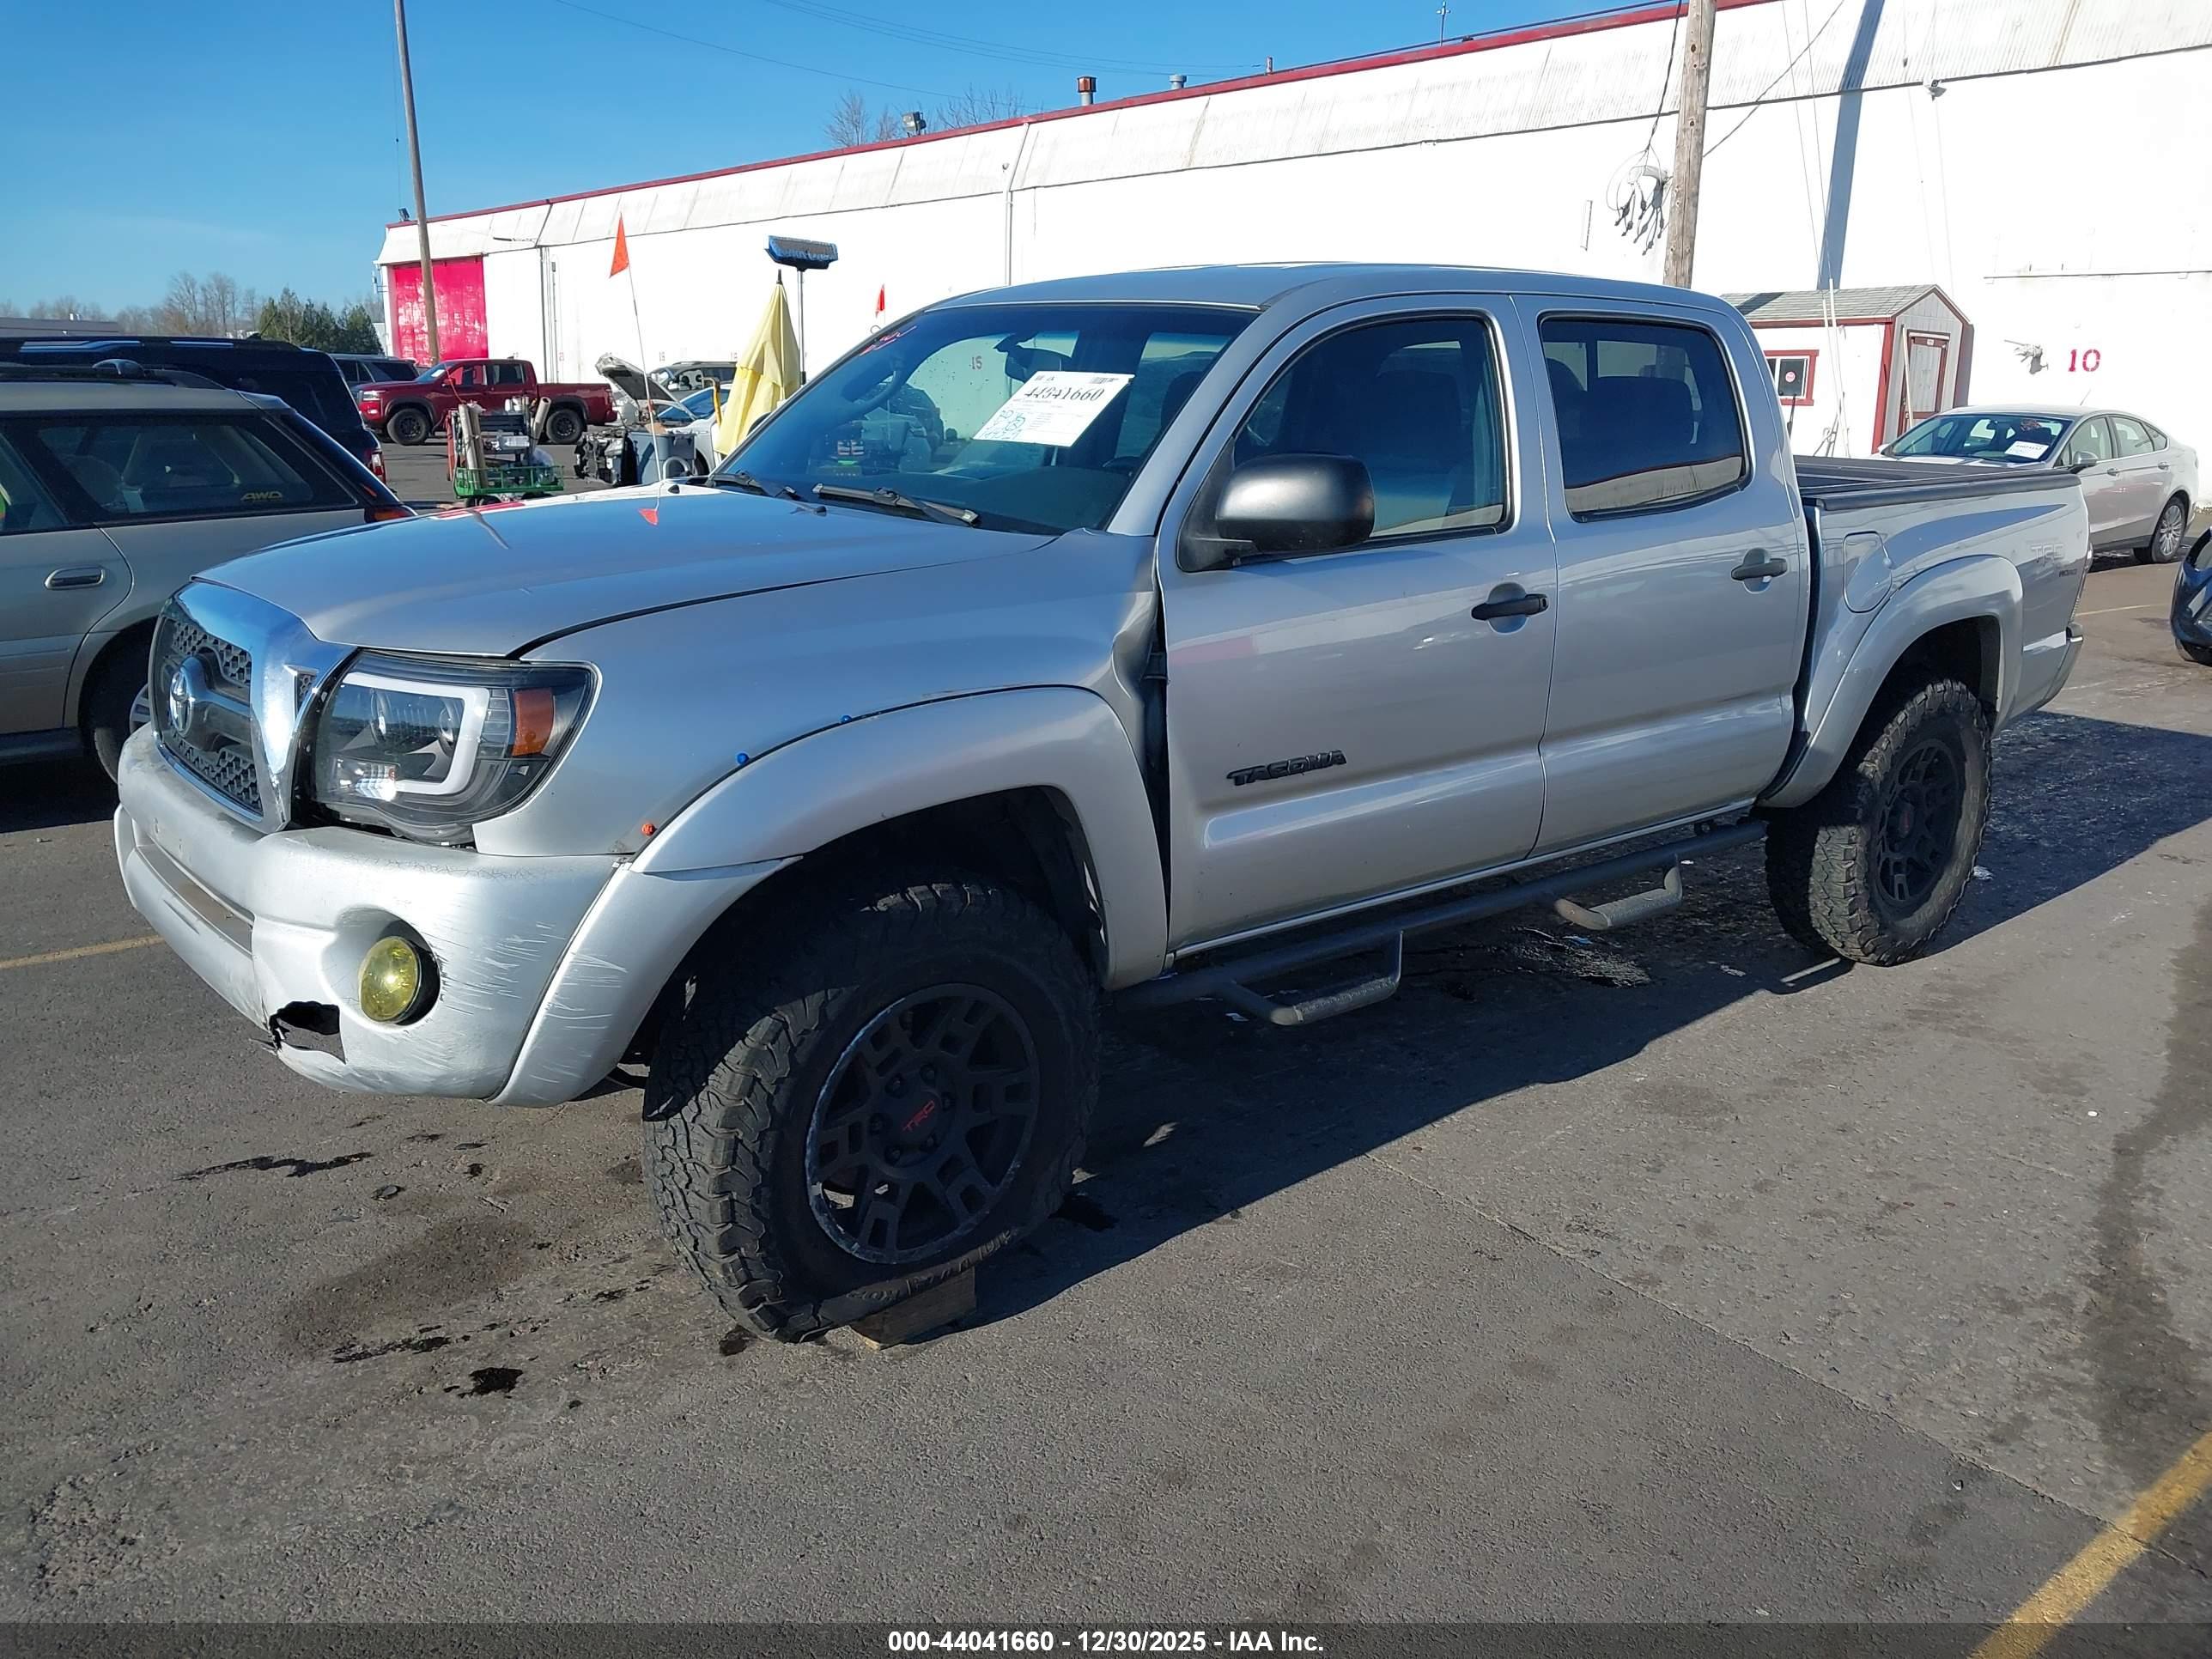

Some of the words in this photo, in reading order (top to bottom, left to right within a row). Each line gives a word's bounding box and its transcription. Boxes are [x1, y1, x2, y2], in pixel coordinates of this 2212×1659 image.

[2068, 349, 2101, 372] 10
[1226, 750, 1347, 786] TACOMA
[902, 1099, 935, 1133] TRD
